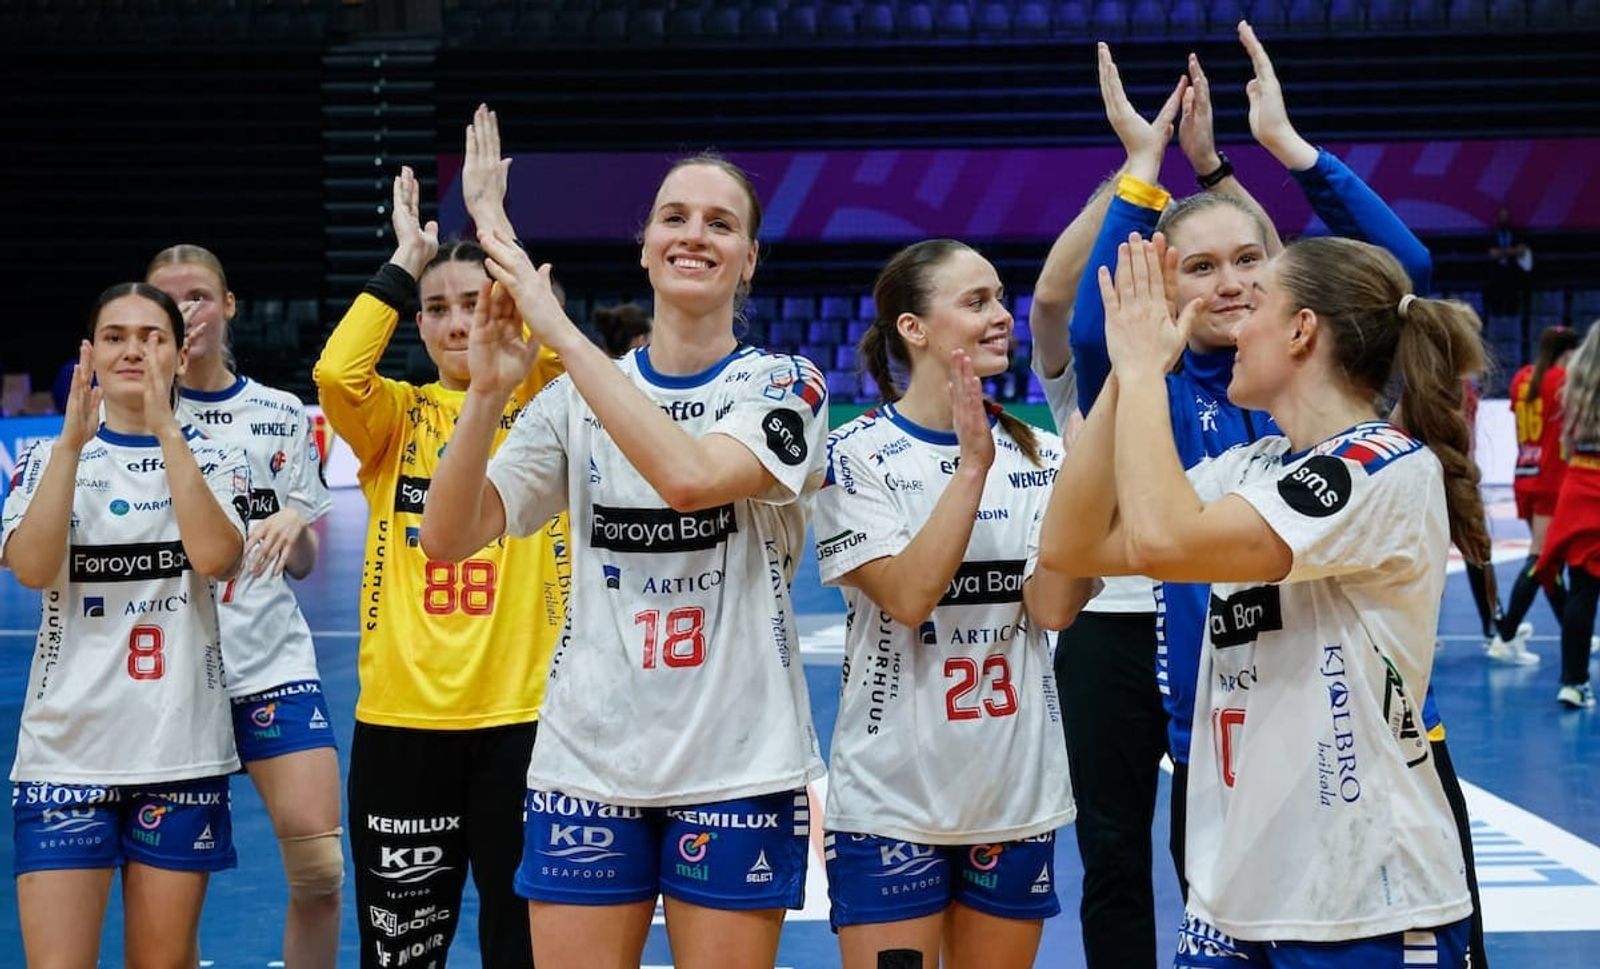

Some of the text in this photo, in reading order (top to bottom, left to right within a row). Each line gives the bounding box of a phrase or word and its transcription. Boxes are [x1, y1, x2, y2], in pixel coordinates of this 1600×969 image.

[770, 417, 801, 459] sms
[940, 456, 961, 475] ef
[1292, 467, 1338, 507] sms
[975, 509, 1009, 520] RÐIN
[593, 514, 674, 547] Føroya
[74, 549, 152, 574] Føroya
[423, 558, 498, 616] 88
[642, 569, 726, 594] ARTICO
[634, 606, 707, 669] 18
[127, 624, 166, 681] 8
[867, 611, 893, 735] DJURHUUS
[889, 652, 901, 699] HOTEL
[944, 653, 1019, 721] 23
[1320, 645, 1361, 803] KJØLBRO
[368, 814, 461, 834] KEMILUX
[550, 824, 615, 848] KD
[132, 827, 162, 847] mál
[381, 846, 443, 869] KD
[542, 867, 616, 879] SEAFOOD
[676, 862, 709, 882] mál
[746, 872, 773, 883] SELECT
